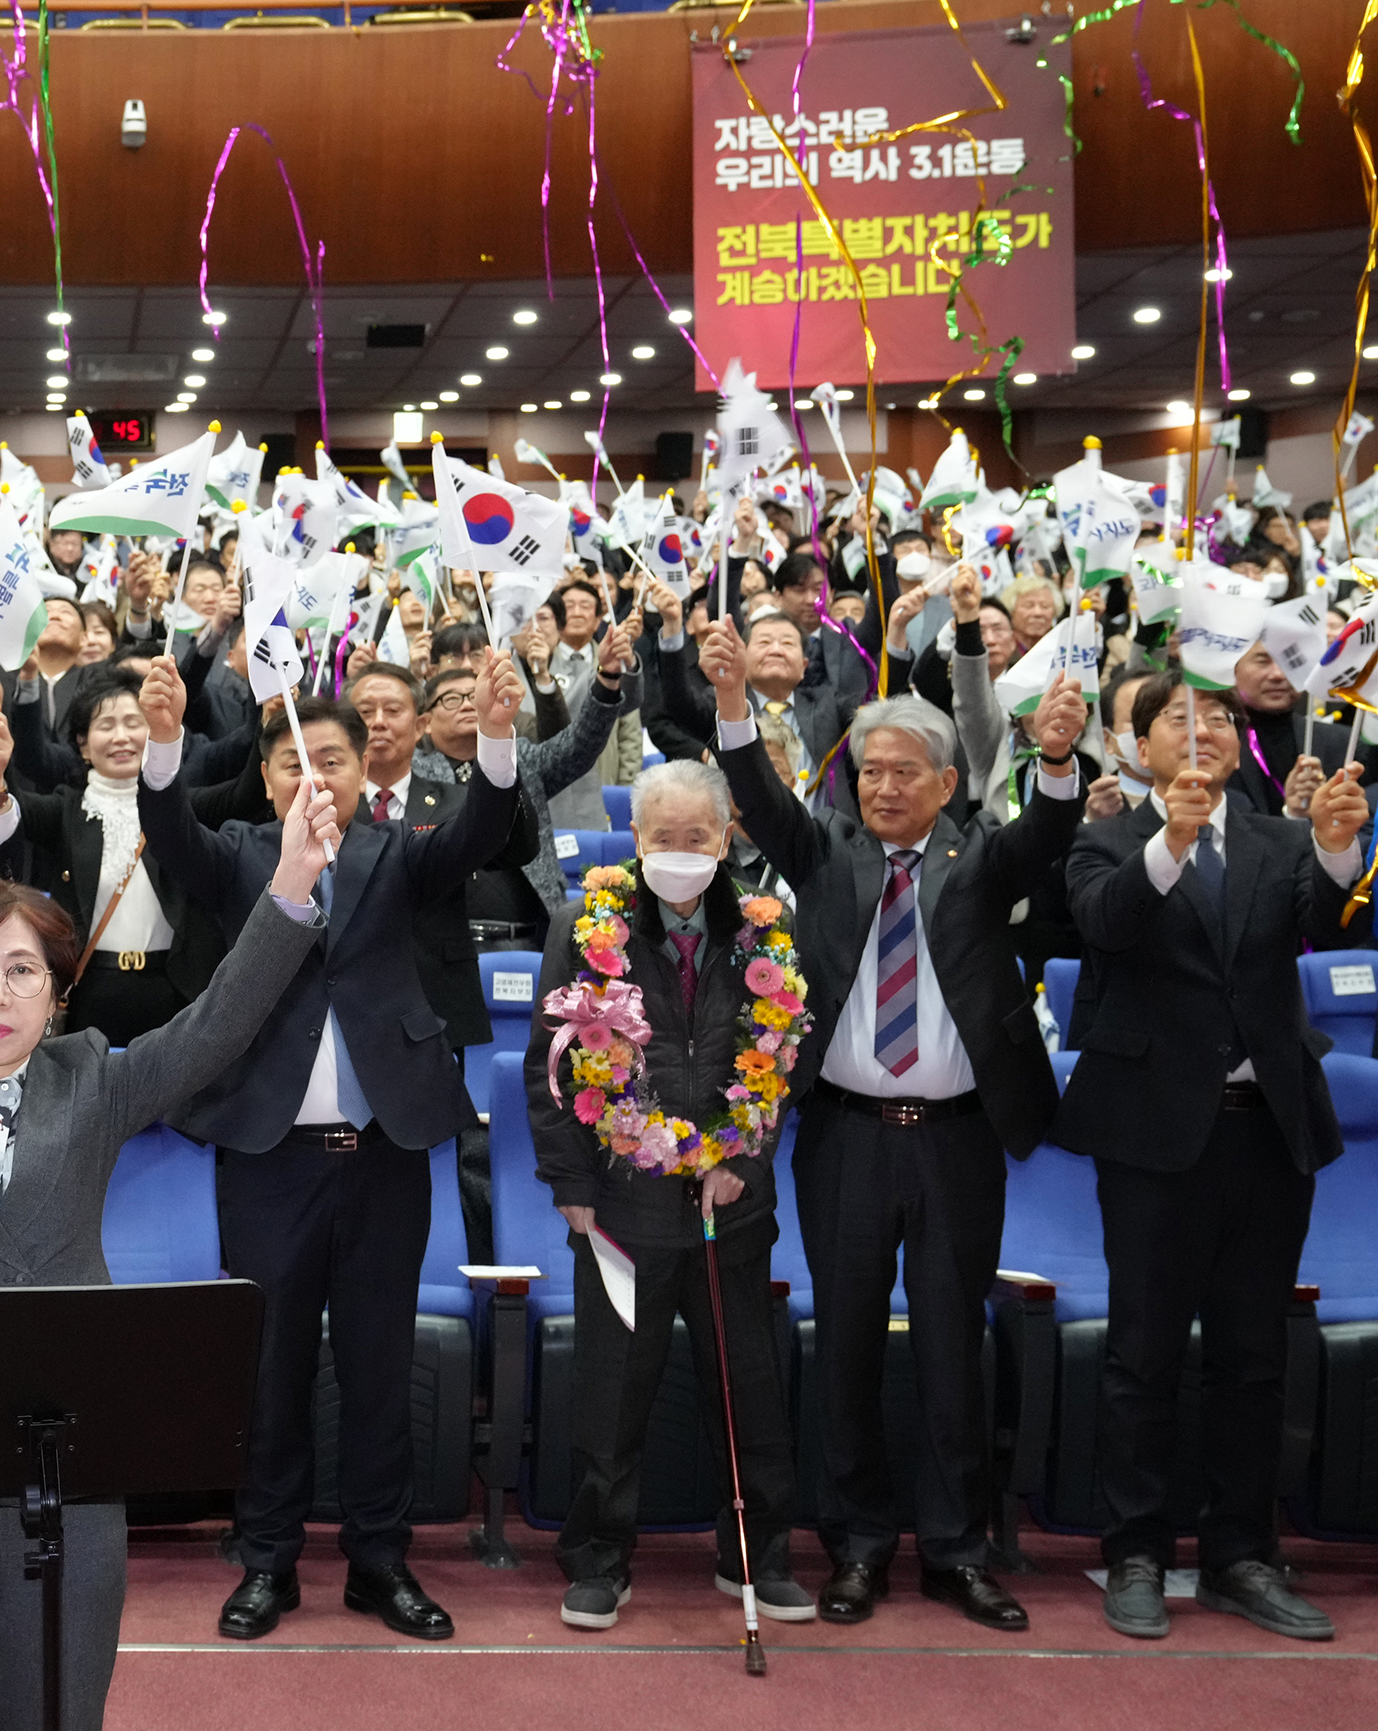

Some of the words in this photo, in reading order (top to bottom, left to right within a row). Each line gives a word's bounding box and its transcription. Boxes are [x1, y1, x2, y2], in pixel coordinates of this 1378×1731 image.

[714, 106, 889, 151] 자랑스러운
[715, 152, 819, 191] 우리의
[828, 145, 901, 184] 역사
[908, 137, 1026, 179] 3.1운동
[717, 210, 1053, 267] 전북특별자치도가
[112, 419, 141, 442] 45
